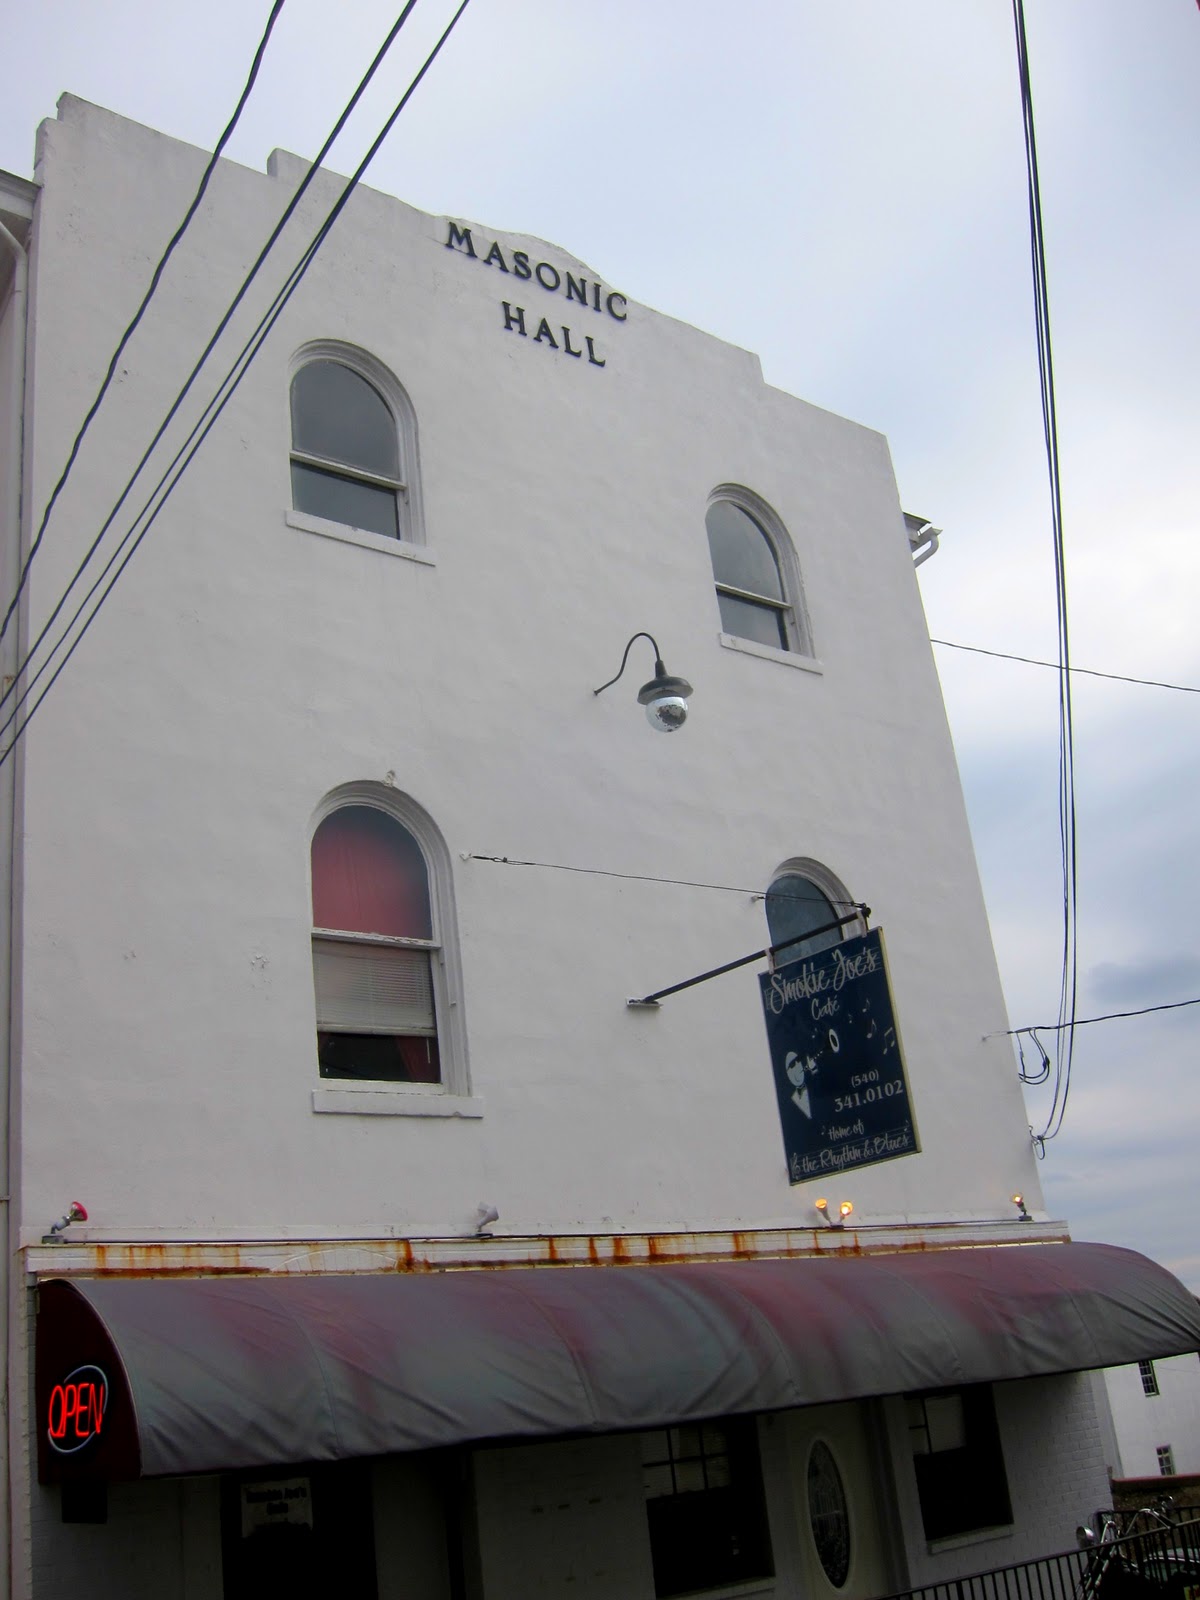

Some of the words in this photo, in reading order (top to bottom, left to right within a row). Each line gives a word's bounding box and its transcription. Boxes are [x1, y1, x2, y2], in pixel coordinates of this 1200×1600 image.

[445, 221, 627, 322] MASONIC
[501, 301, 606, 368] HALL
[770, 962, 831, 1014] Smokie
[832, 946, 878, 991] Joe's
[834, 1079, 904, 1113] 341.0102
[851, 1069, 879, 1088] (540)
[820, 1145, 861, 1171] Rhythm
[874, 1133, 910, 1155] Blues
[48, 1382, 104, 1438] OPEN
